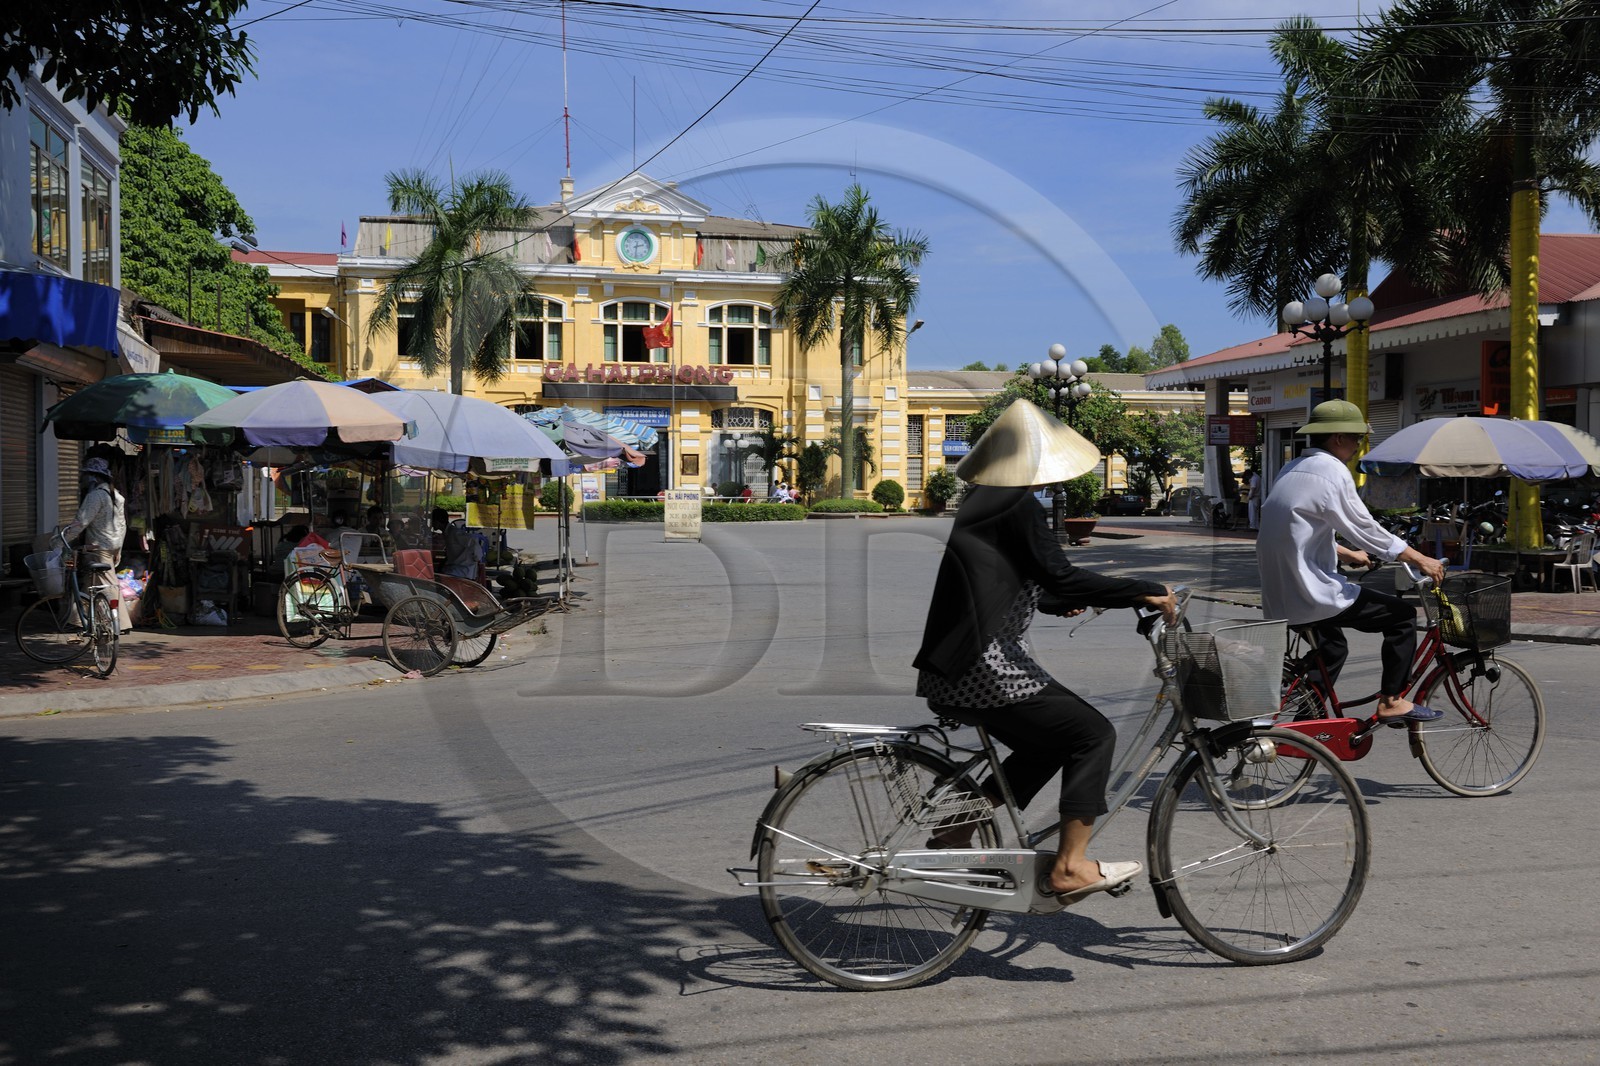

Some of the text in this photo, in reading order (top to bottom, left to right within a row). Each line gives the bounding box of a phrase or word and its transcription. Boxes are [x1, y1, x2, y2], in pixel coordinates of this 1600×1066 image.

[545, 362, 734, 384] GA HAI PHONG
[1250, 396, 1272, 406] Canon
